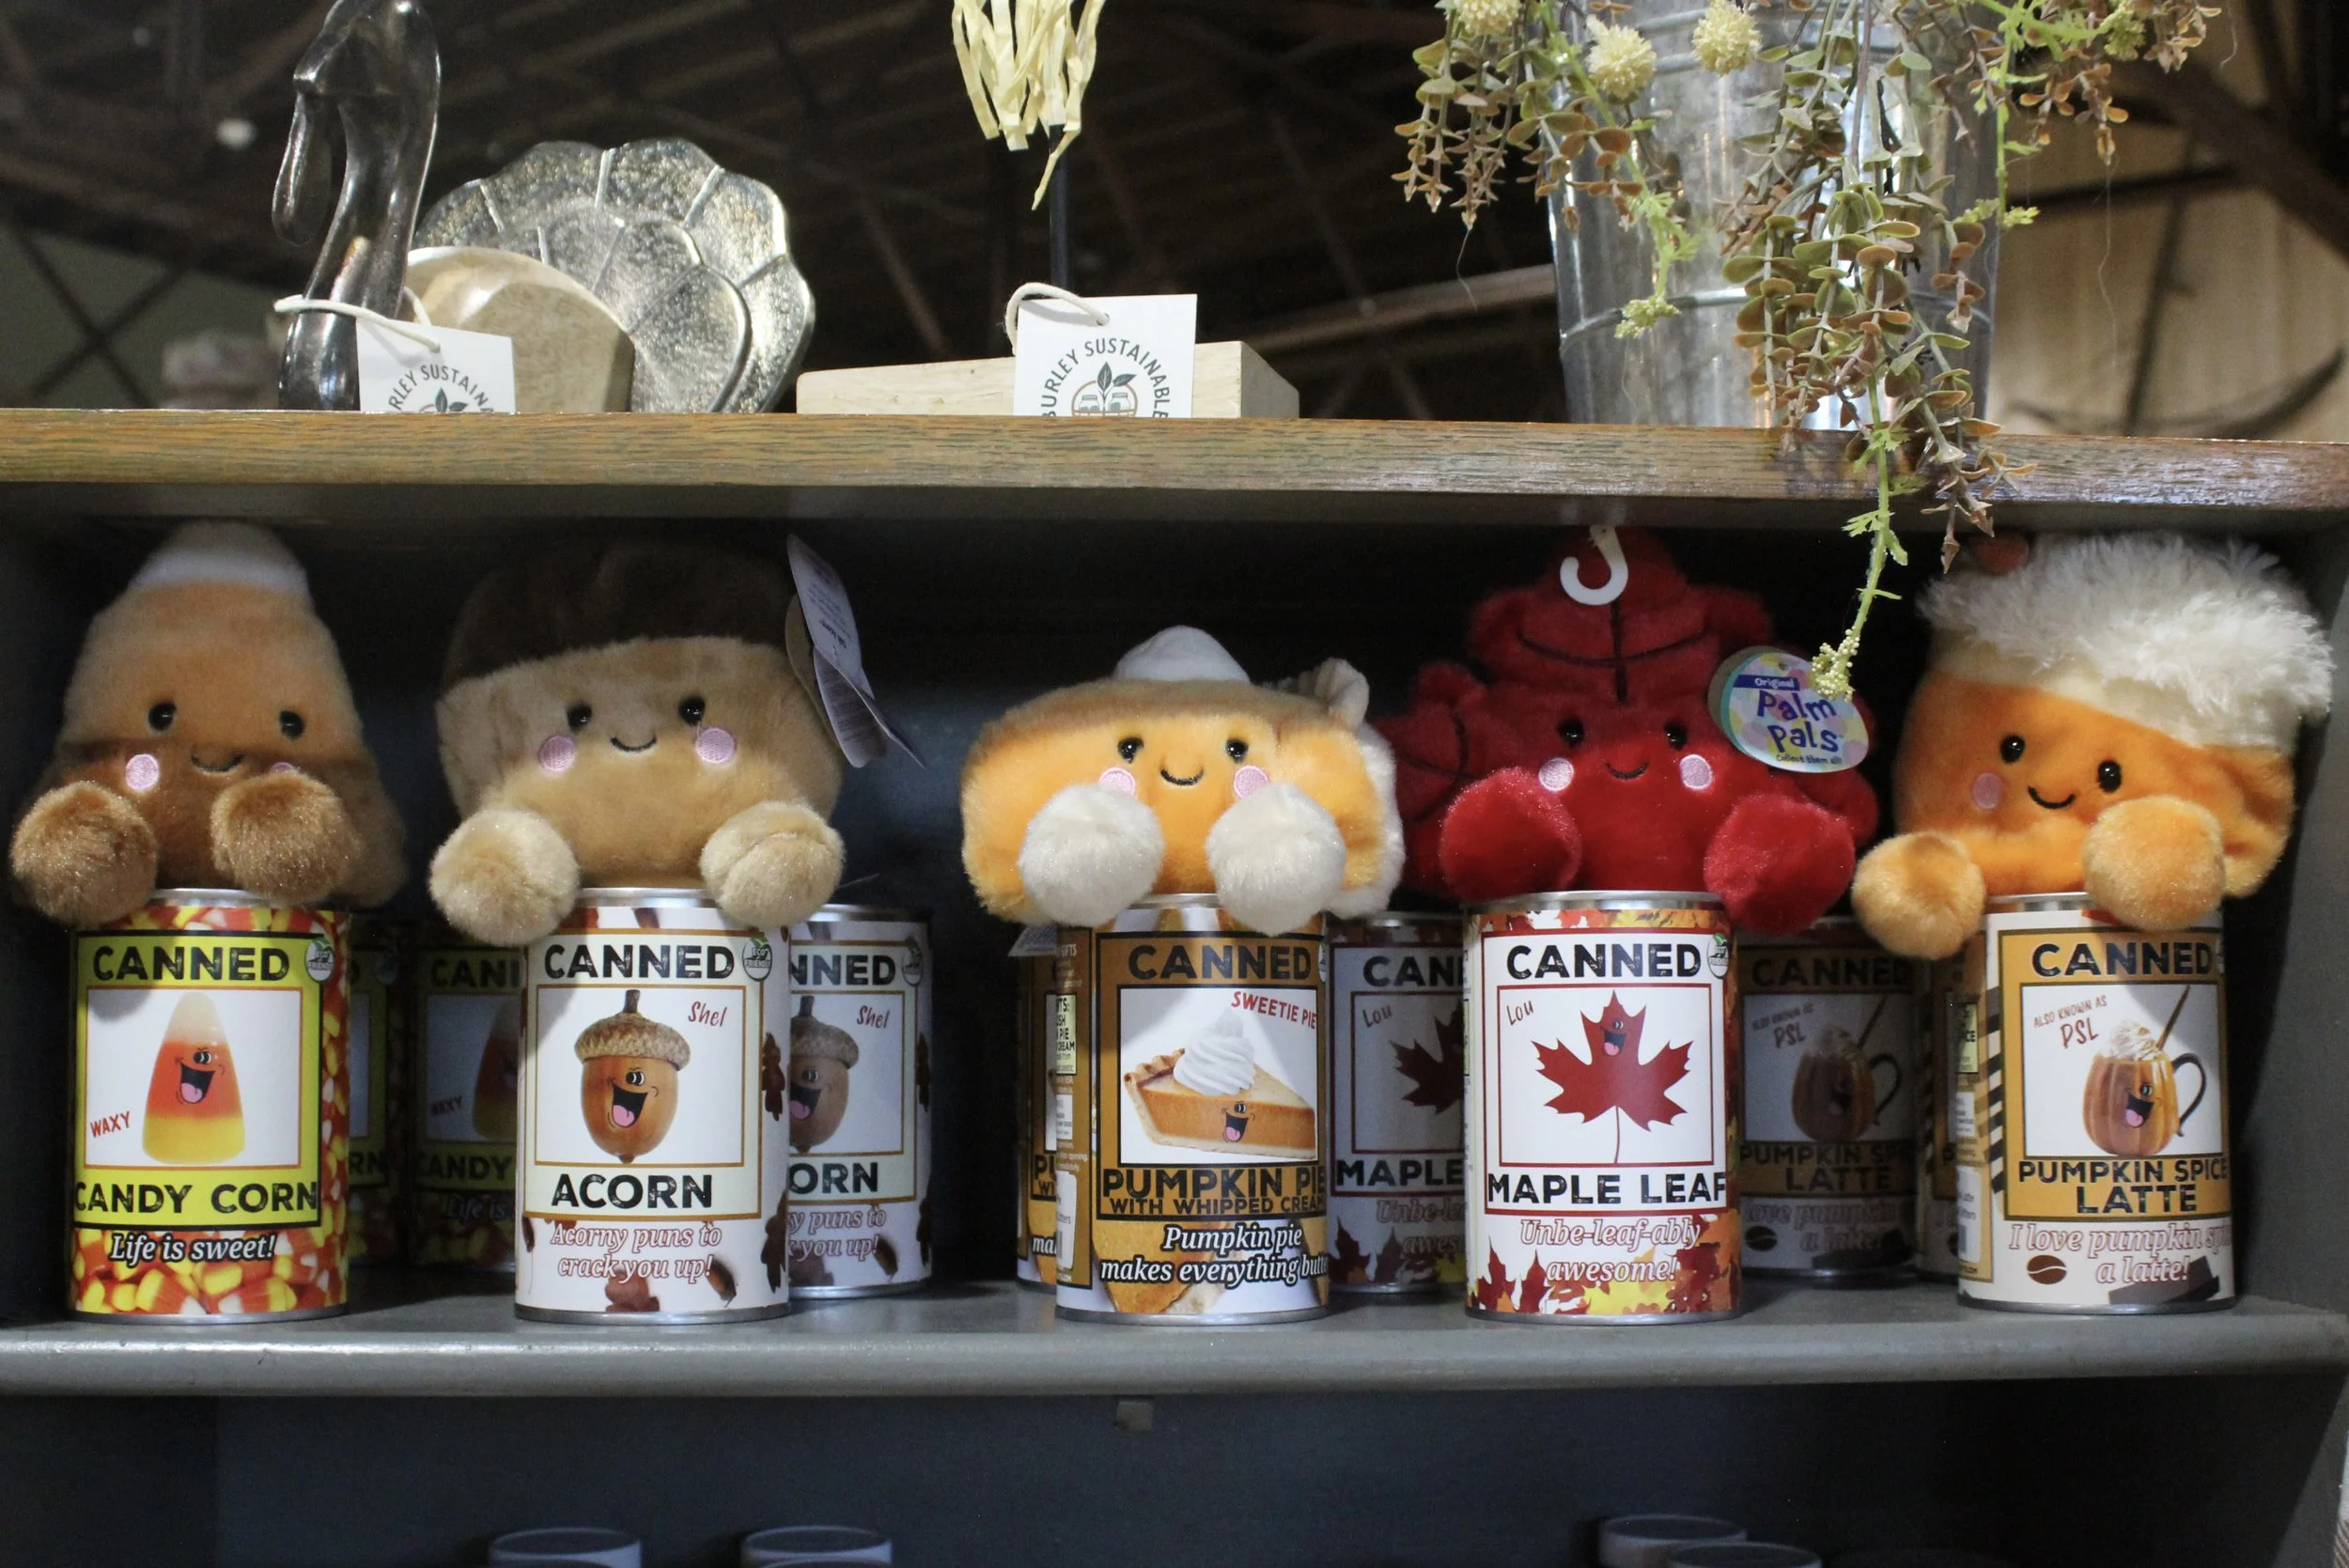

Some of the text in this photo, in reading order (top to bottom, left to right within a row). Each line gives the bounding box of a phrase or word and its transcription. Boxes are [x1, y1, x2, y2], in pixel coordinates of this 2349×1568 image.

[388, 364, 494, 412] RLEY SUSTAIN
[1084, 337, 1171, 418] SUSTAINABLE
[1754, 677, 1795, 690] Original
[1756, 690, 1837, 722] Palm
[1766, 721, 1839, 753] Pals
[93, 945, 289, 982] CANNED
[545, 944, 734, 979] CANNED
[790, 955, 895, 986] NNED
[1128, 945, 1311, 980] CANNED
[1363, 955, 1463, 987] CAN
[1506, 944, 1702, 979] CANNED
[1752, 957, 1913, 986] CANNED
[2032, 942, 2213, 977] CANNED
[688, 1001, 727, 1027] Shel
[857, 1005, 892, 1029] Shel
[1231, 990, 1316, 1029] SWEETIE PIE
[1362, 1004, 1393, 1029] Lou
[1506, 1000, 1534, 1026] Lou
[2034, 995, 2108, 1028] ALSO KNOWN AS
[2060, 1017, 2099, 1049] PSL
[90, 1110, 131, 1138] WAXY
[349, 1152, 387, 1174] RN
[1739, 1143, 1860, 1165] PUMPKIN
[789, 1162, 878, 1194] ORN
[1103, 1166, 1325, 1198] PUMPKIN PIE
[1336, 1159, 1464, 1186] MAPLE
[1786, 1167, 1890, 1191] LATTE
[2019, 1157, 2228, 1184] PUMPKIN SPICE
[74, 1181, 319, 1214] CANDY CORN
[552, 1173, 712, 1209] ACORN
[1488, 1173, 1726, 1204] MAPLE LEAF
[2076, 1184, 2197, 1215] LATTE
[809, 1211, 863, 1234] puns
[867, 1207, 886, 1227] to
[1110, 1198, 1163, 1215] WITH
[1174, 1197, 1273, 1214] WHIPPED
[110, 1232, 277, 1267] Life is sweet!
[551, 1223, 723, 1253] Acorny puns to
[798, 1239, 842, 1262] you
[847, 1234, 879, 1262] up!
[1163, 1224, 1302, 1259] Pumpkin pie
[1519, 1217, 1701, 1251] Unbe-leaf-ably
[2009, 1224, 2024, 1250] I
[2026, 1223, 2082, 1250] love
[2088, 1221, 2203, 1258] pumpkin
[557, 1254, 713, 1283] crack you up!
[1101, 1257, 1172, 1282] makes
[1179, 1257, 1298, 1287] everything
[1546, 1255, 1679, 1283] awesome!
[2095, 1255, 2190, 1284] a latte!
